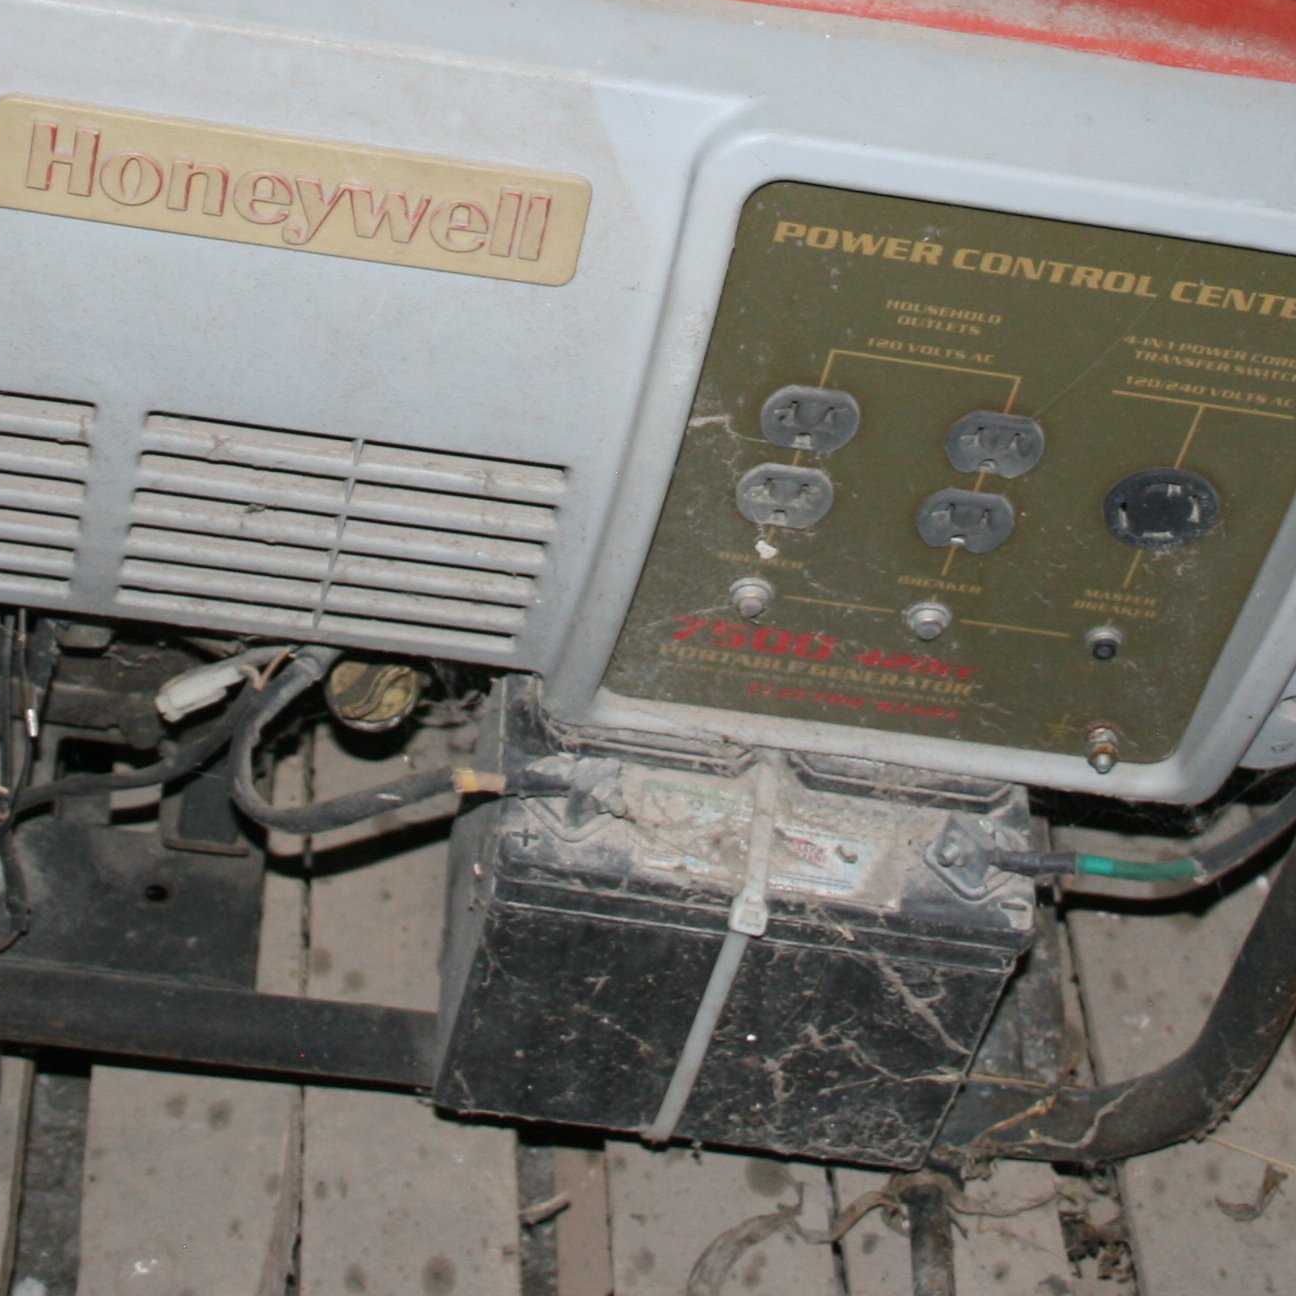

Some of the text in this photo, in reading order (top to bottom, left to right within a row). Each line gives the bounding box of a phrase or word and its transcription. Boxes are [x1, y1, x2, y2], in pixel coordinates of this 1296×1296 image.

[25, 119, 553, 263] Honeywell
[772, 220, 943, 265] POWER
[951, 248, 1158, 298] CONTROL
[885, 299, 1003, 325] HOUSEHOLD
[896, 315, 982, 336] OUTLETS
[867, 337, 995, 365] 120 VOLTS AC
[1134, 349, 1231, 373] TRANSFER
[1178, 342, 1248, 362] POWER
[1124, 375, 1294, 409] 120/240 VOLTS AC
[897, 574, 984, 596] BREAKER
[1082, 587, 1158, 607] MASTER
[1073, 599, 1158, 619] BREAKER
[670, 613, 837, 662] 7500
[657, 642, 808, 678] PORTABLE
[808, 659, 974, 698] GENERATOR
